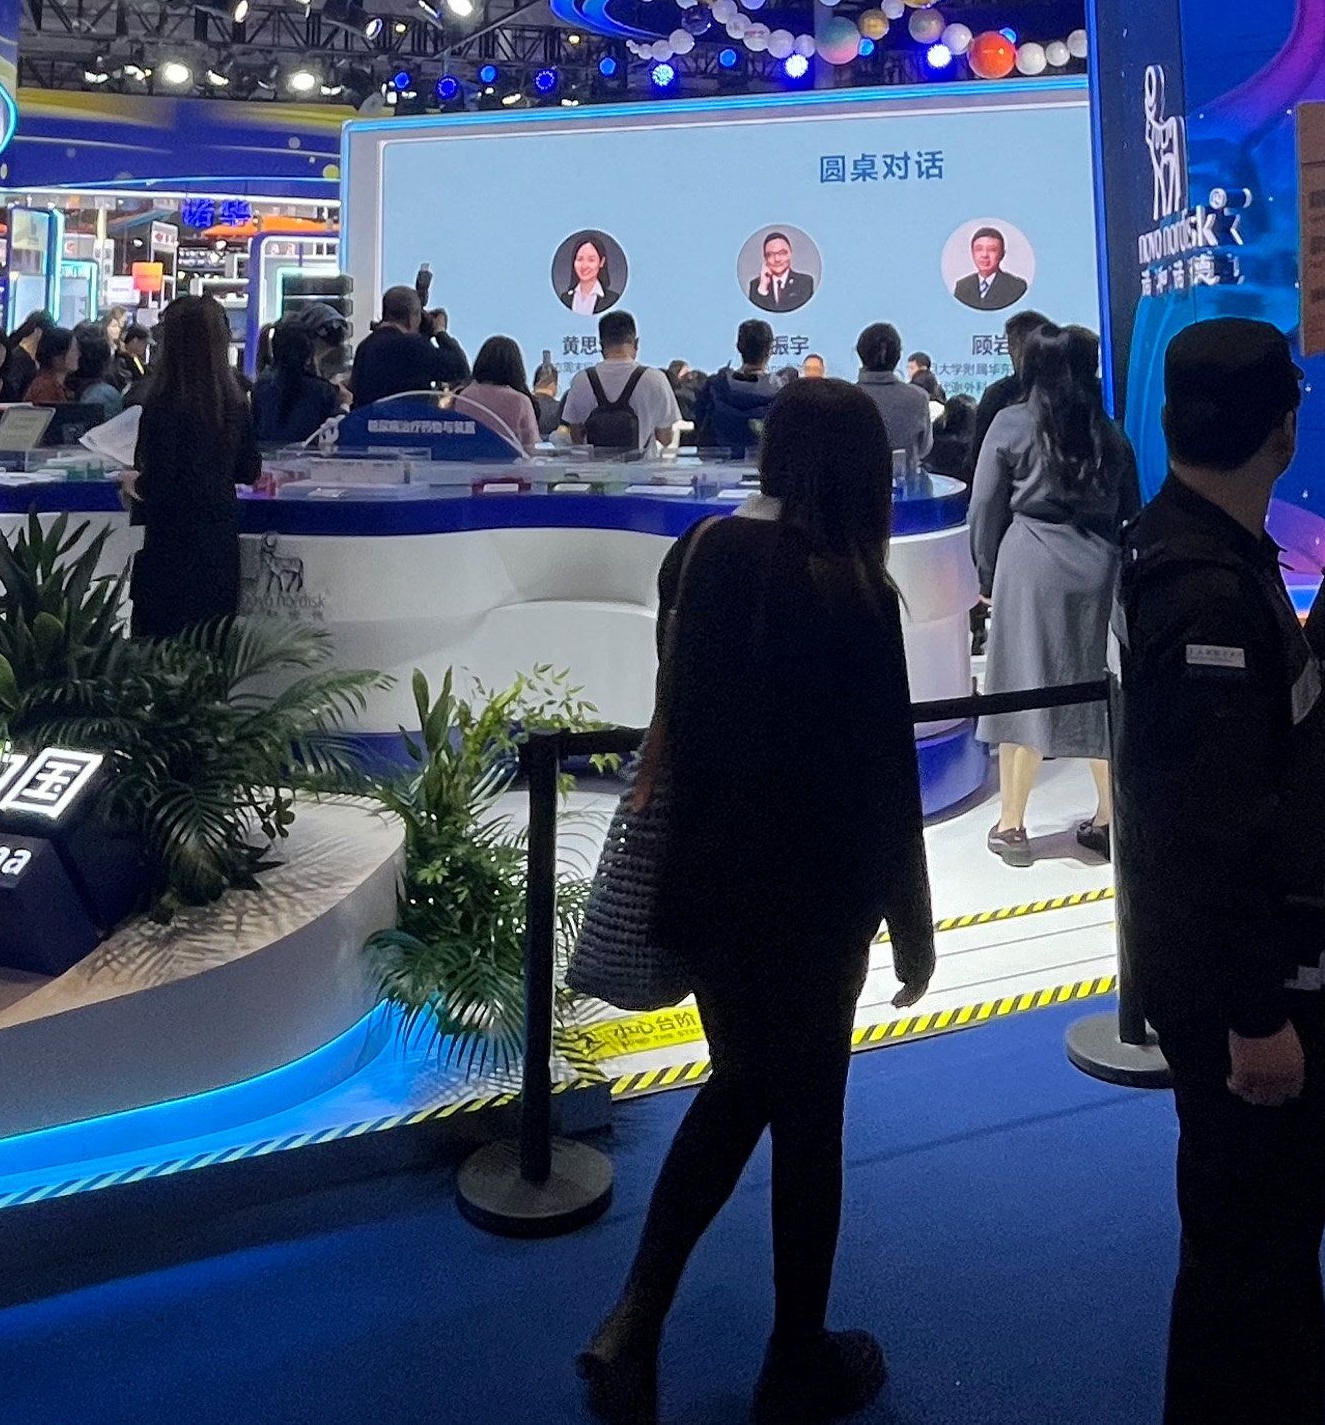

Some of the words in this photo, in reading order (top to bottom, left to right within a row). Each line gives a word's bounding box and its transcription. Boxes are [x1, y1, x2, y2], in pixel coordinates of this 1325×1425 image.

[819, 149, 945, 186] 圆桌对话
[562, 335, 602, 356] 黄思
